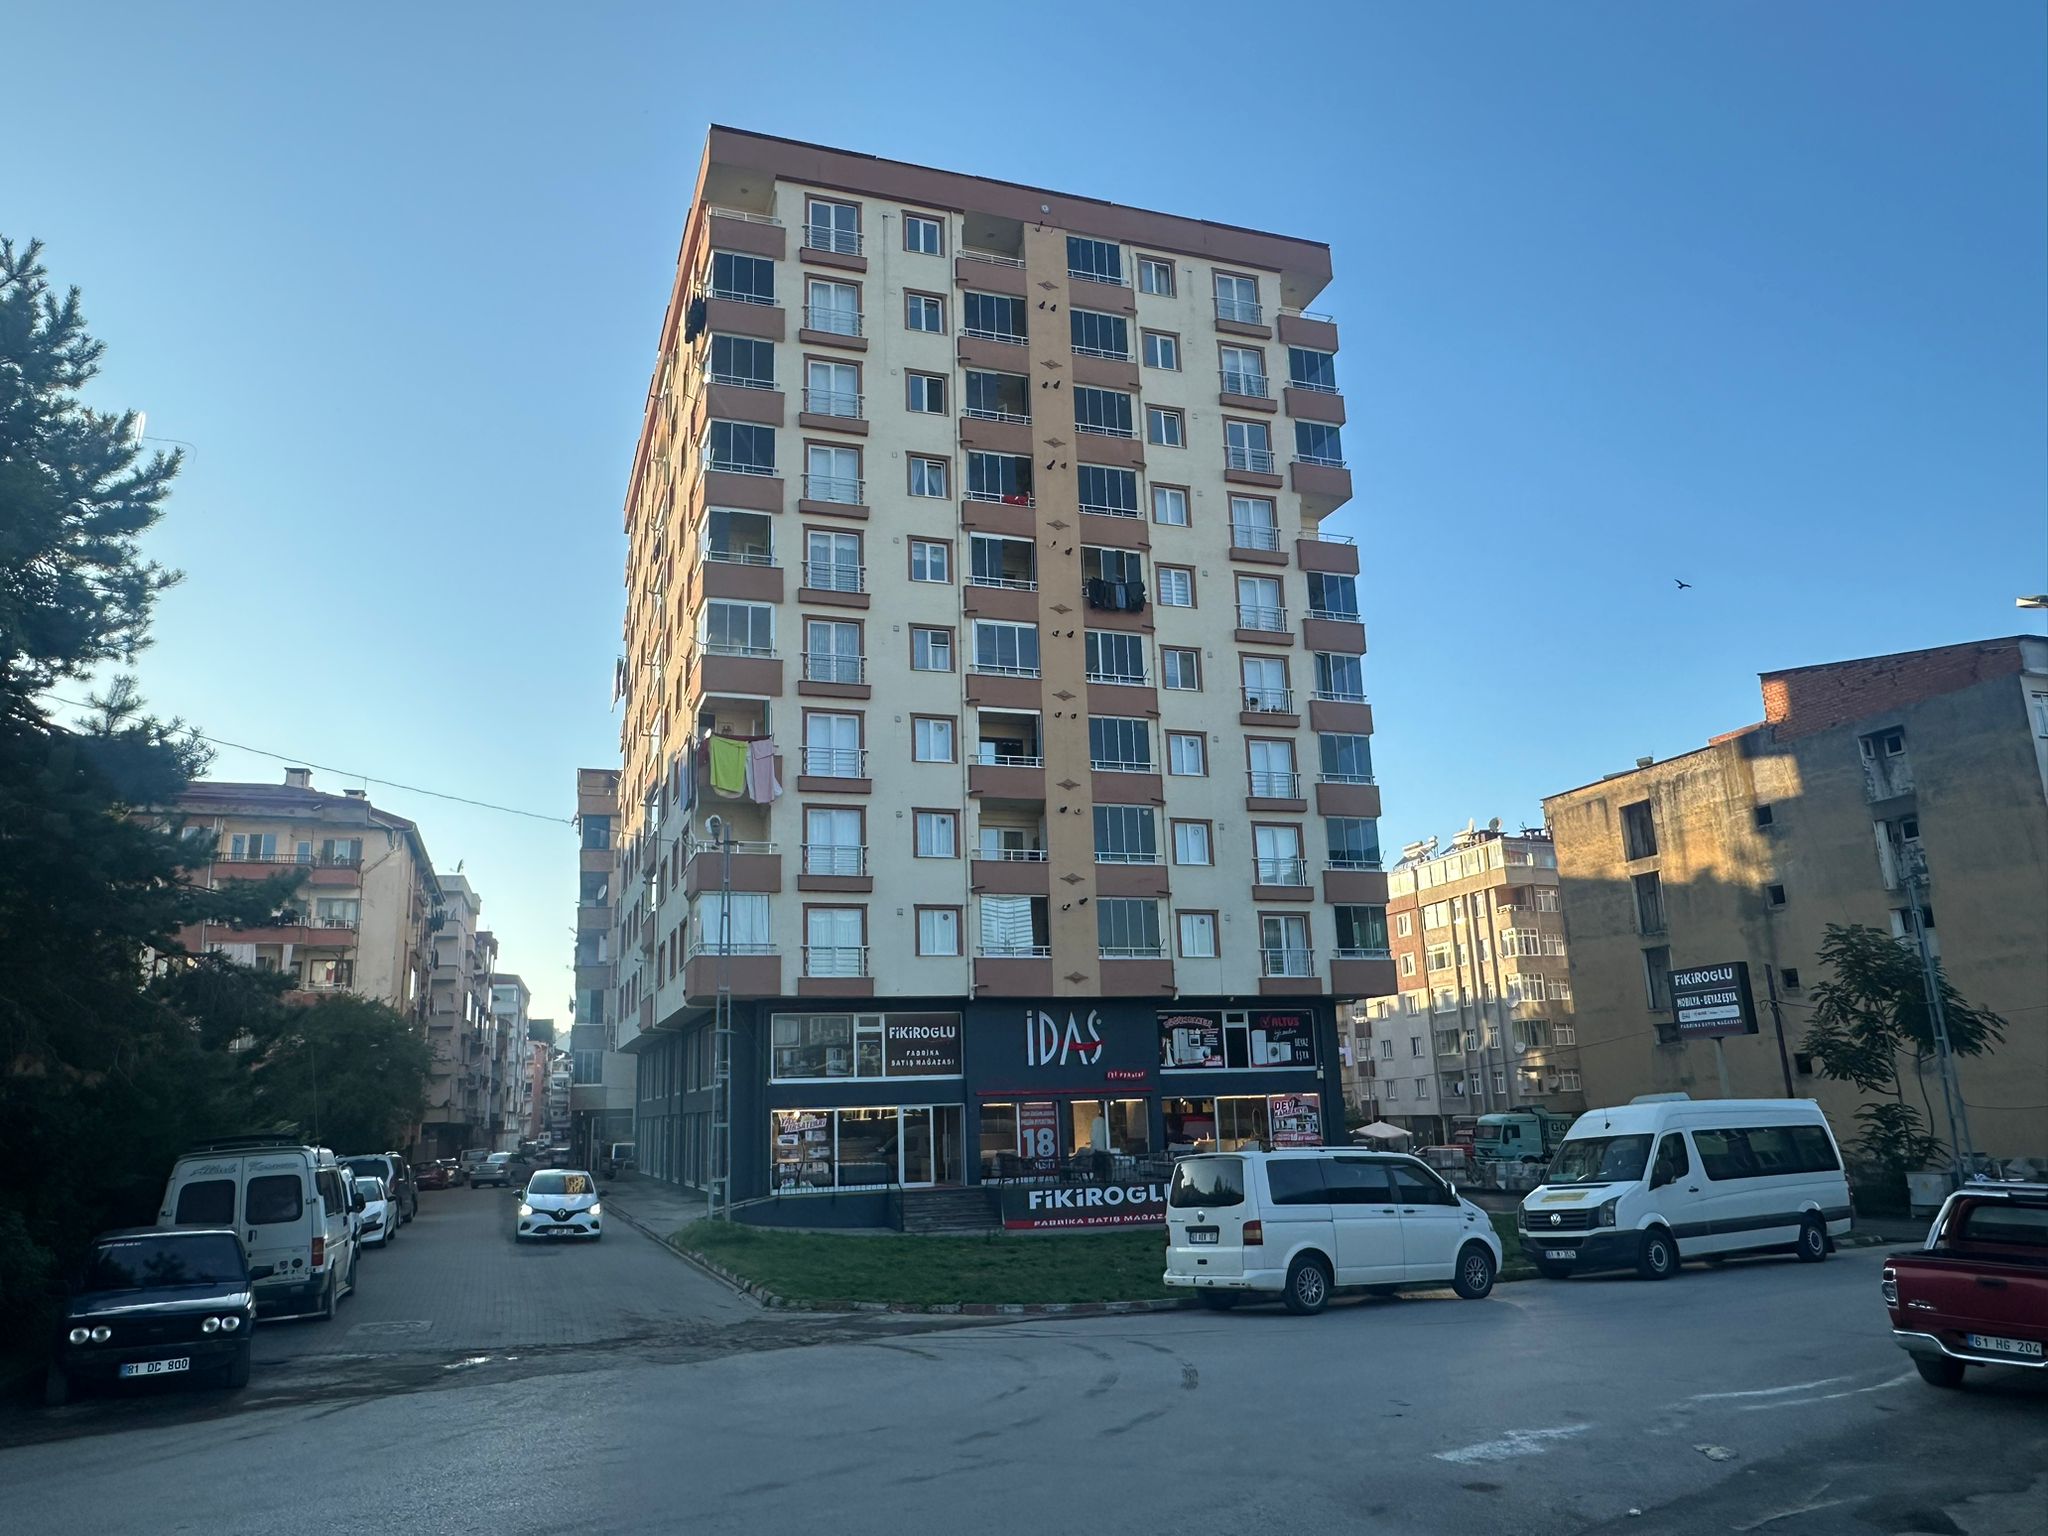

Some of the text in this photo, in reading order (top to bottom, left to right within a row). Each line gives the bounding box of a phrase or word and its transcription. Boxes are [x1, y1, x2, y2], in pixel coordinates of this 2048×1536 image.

[1022, 1127, 1056, 1159] 18
[1974, 1336, 2040, 1354] 61 HG 204
[128, 1364, 139, 1374] 81
[168, 1359, 188, 1370] 800
